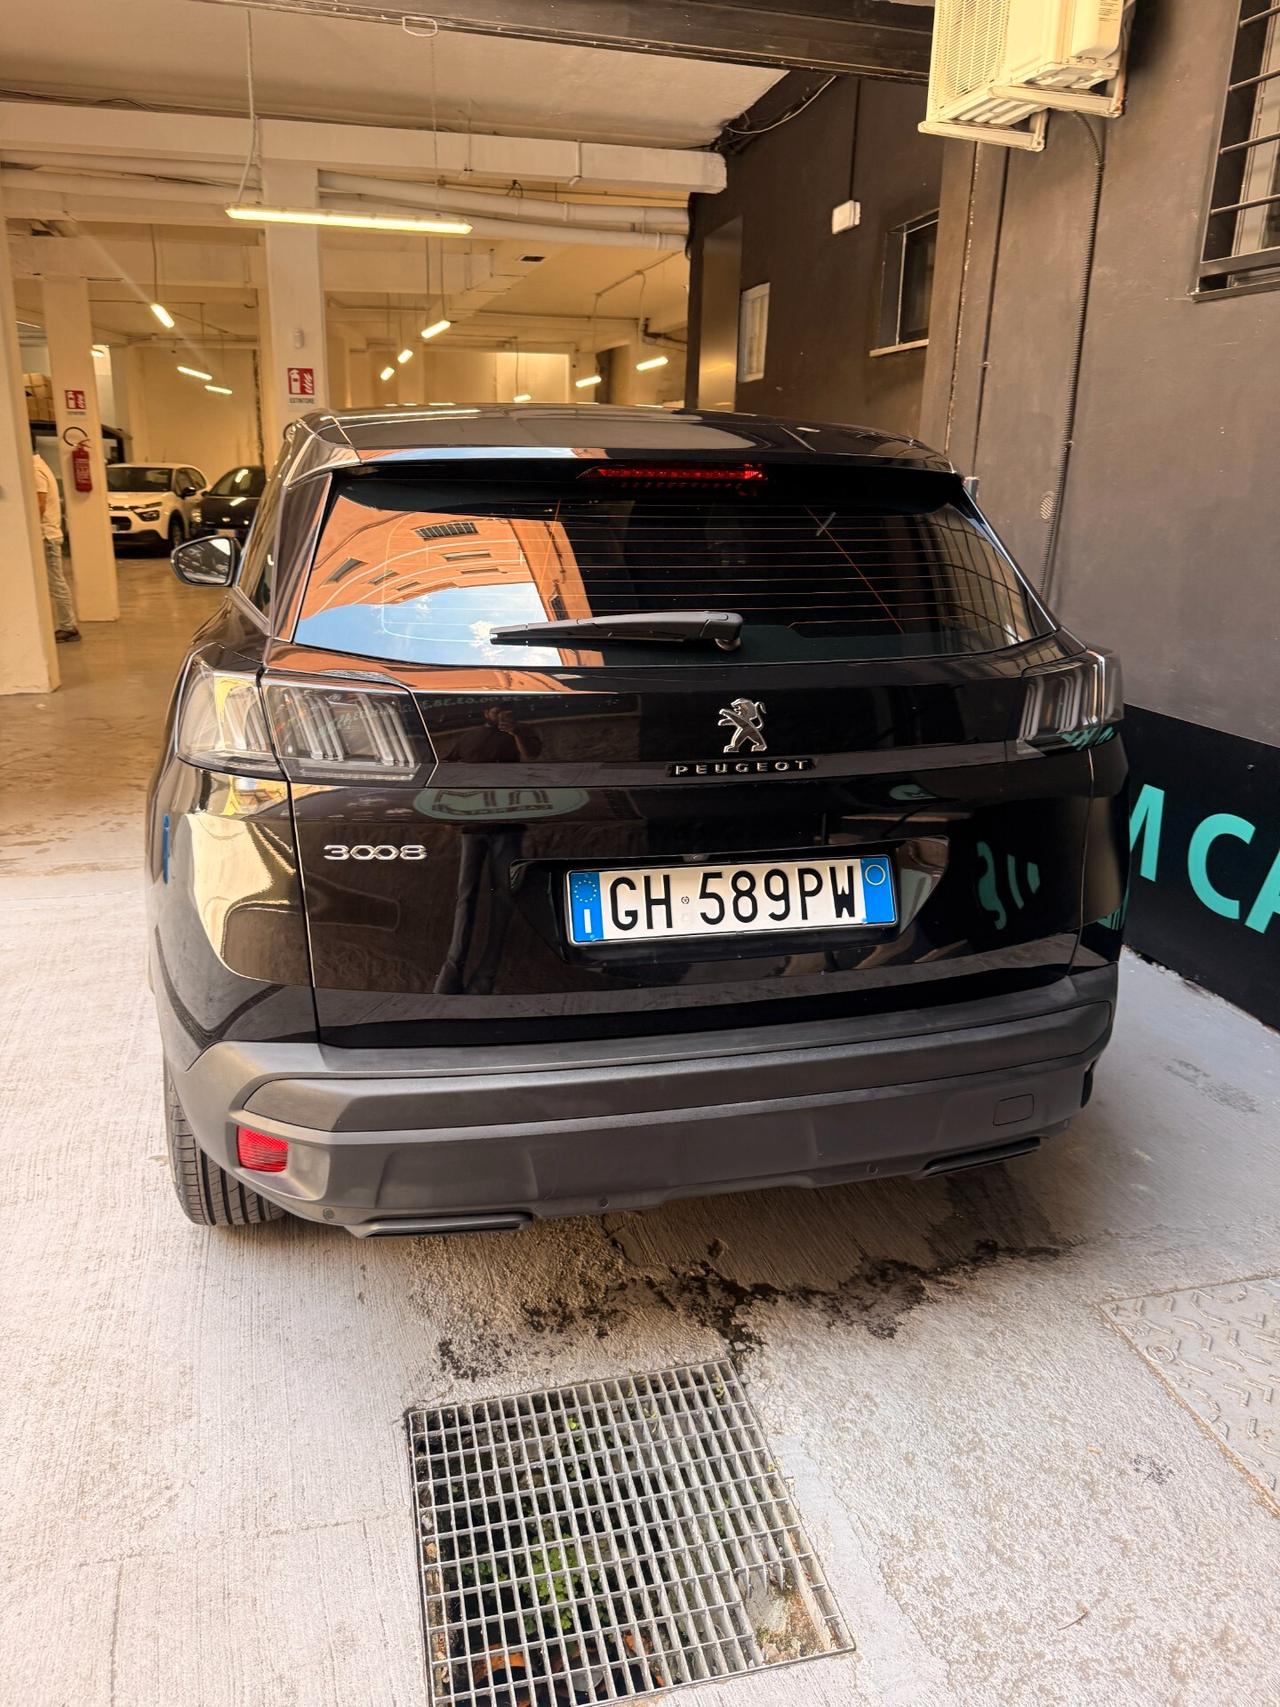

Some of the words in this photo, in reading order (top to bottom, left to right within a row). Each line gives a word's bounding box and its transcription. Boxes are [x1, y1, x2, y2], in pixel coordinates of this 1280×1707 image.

[674, 759, 809, 776] PEUGEOT
[322, 844, 428, 861] 3008
[609, 873, 674, 931] GH
[699, 864, 856, 926] 589PW
